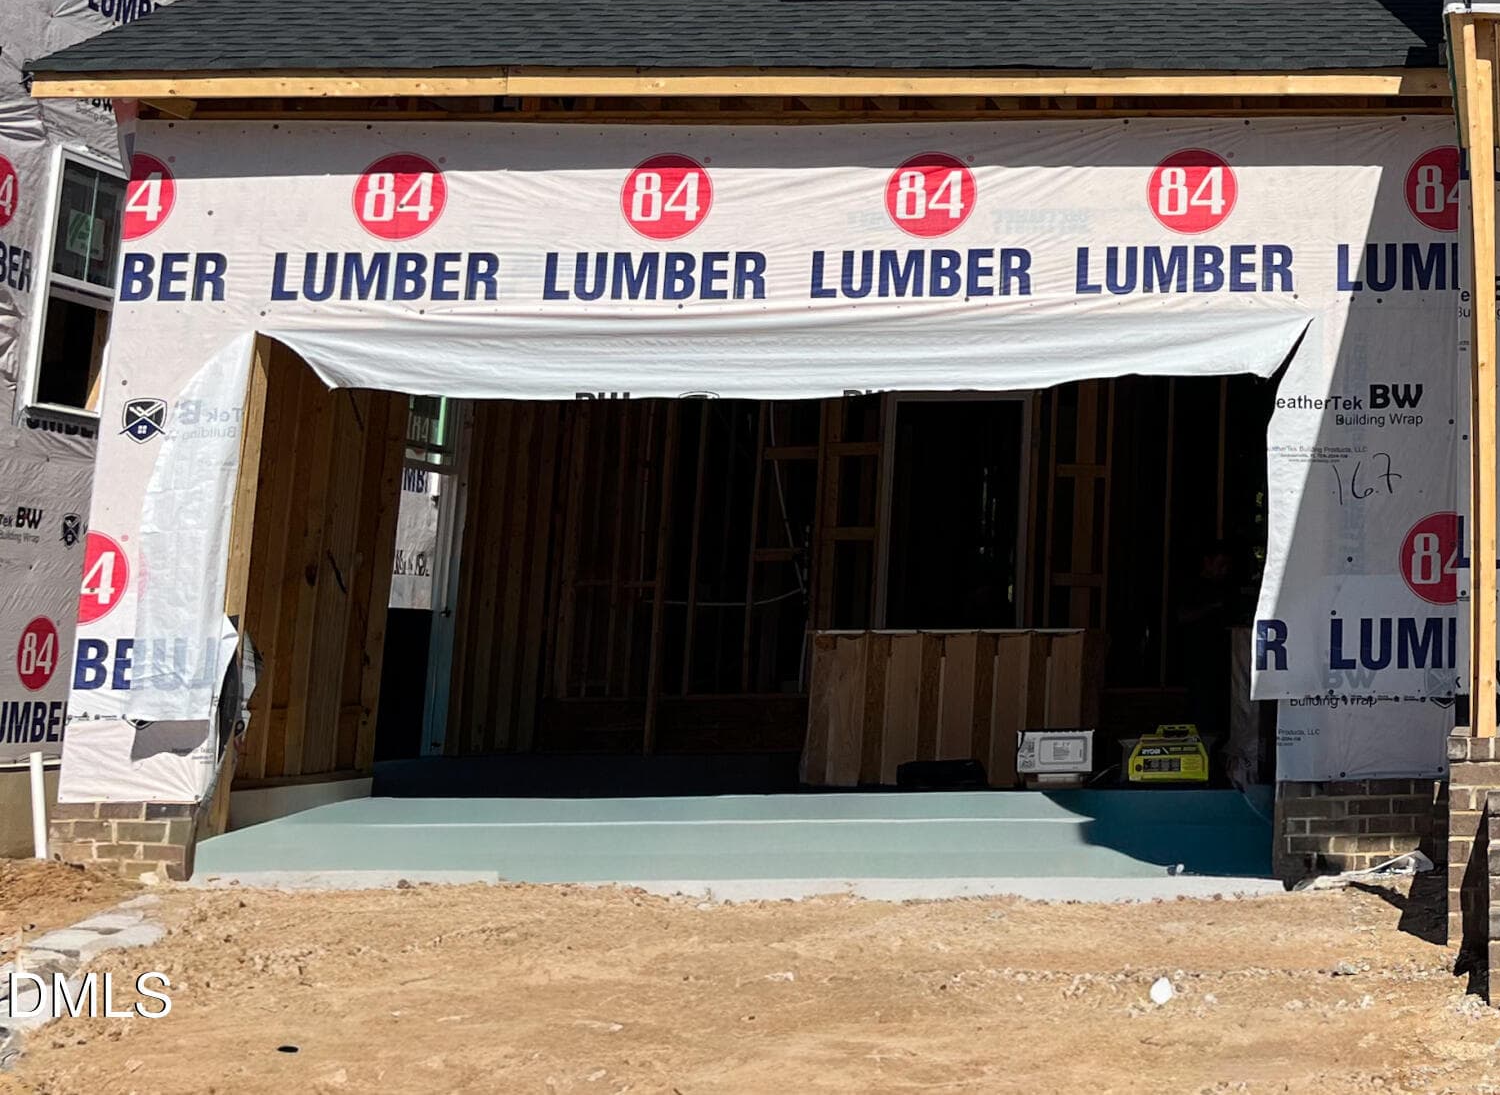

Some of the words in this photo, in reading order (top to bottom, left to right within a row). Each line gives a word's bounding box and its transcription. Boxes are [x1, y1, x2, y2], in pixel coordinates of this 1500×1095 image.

[363, 172, 435, 222] 84
[631, 172, 700, 222] 84
[896, 170, 964, 220] 84
[1158, 167, 1226, 216] 84
[119, 252, 228, 302] BER
[270, 251, 500, 302] LUMBER
[542, 251, 767, 301] LUMBER
[810, 247, 1032, 299] LUMBER
[1075, 244, 1294, 295] LUMBER
[1337, 242, 1458, 292] LUM
[1276, 395, 1363, 410] eatherTek
[1369, 384, 1423, 409] BW
[1336, 414, 1385, 427] Building
[1389, 414, 1423, 426] Wrap
[16, 506, 43, 530] BW
[20, 632, 54, 675] 84
[1329, 617, 1456, 671] LUM
